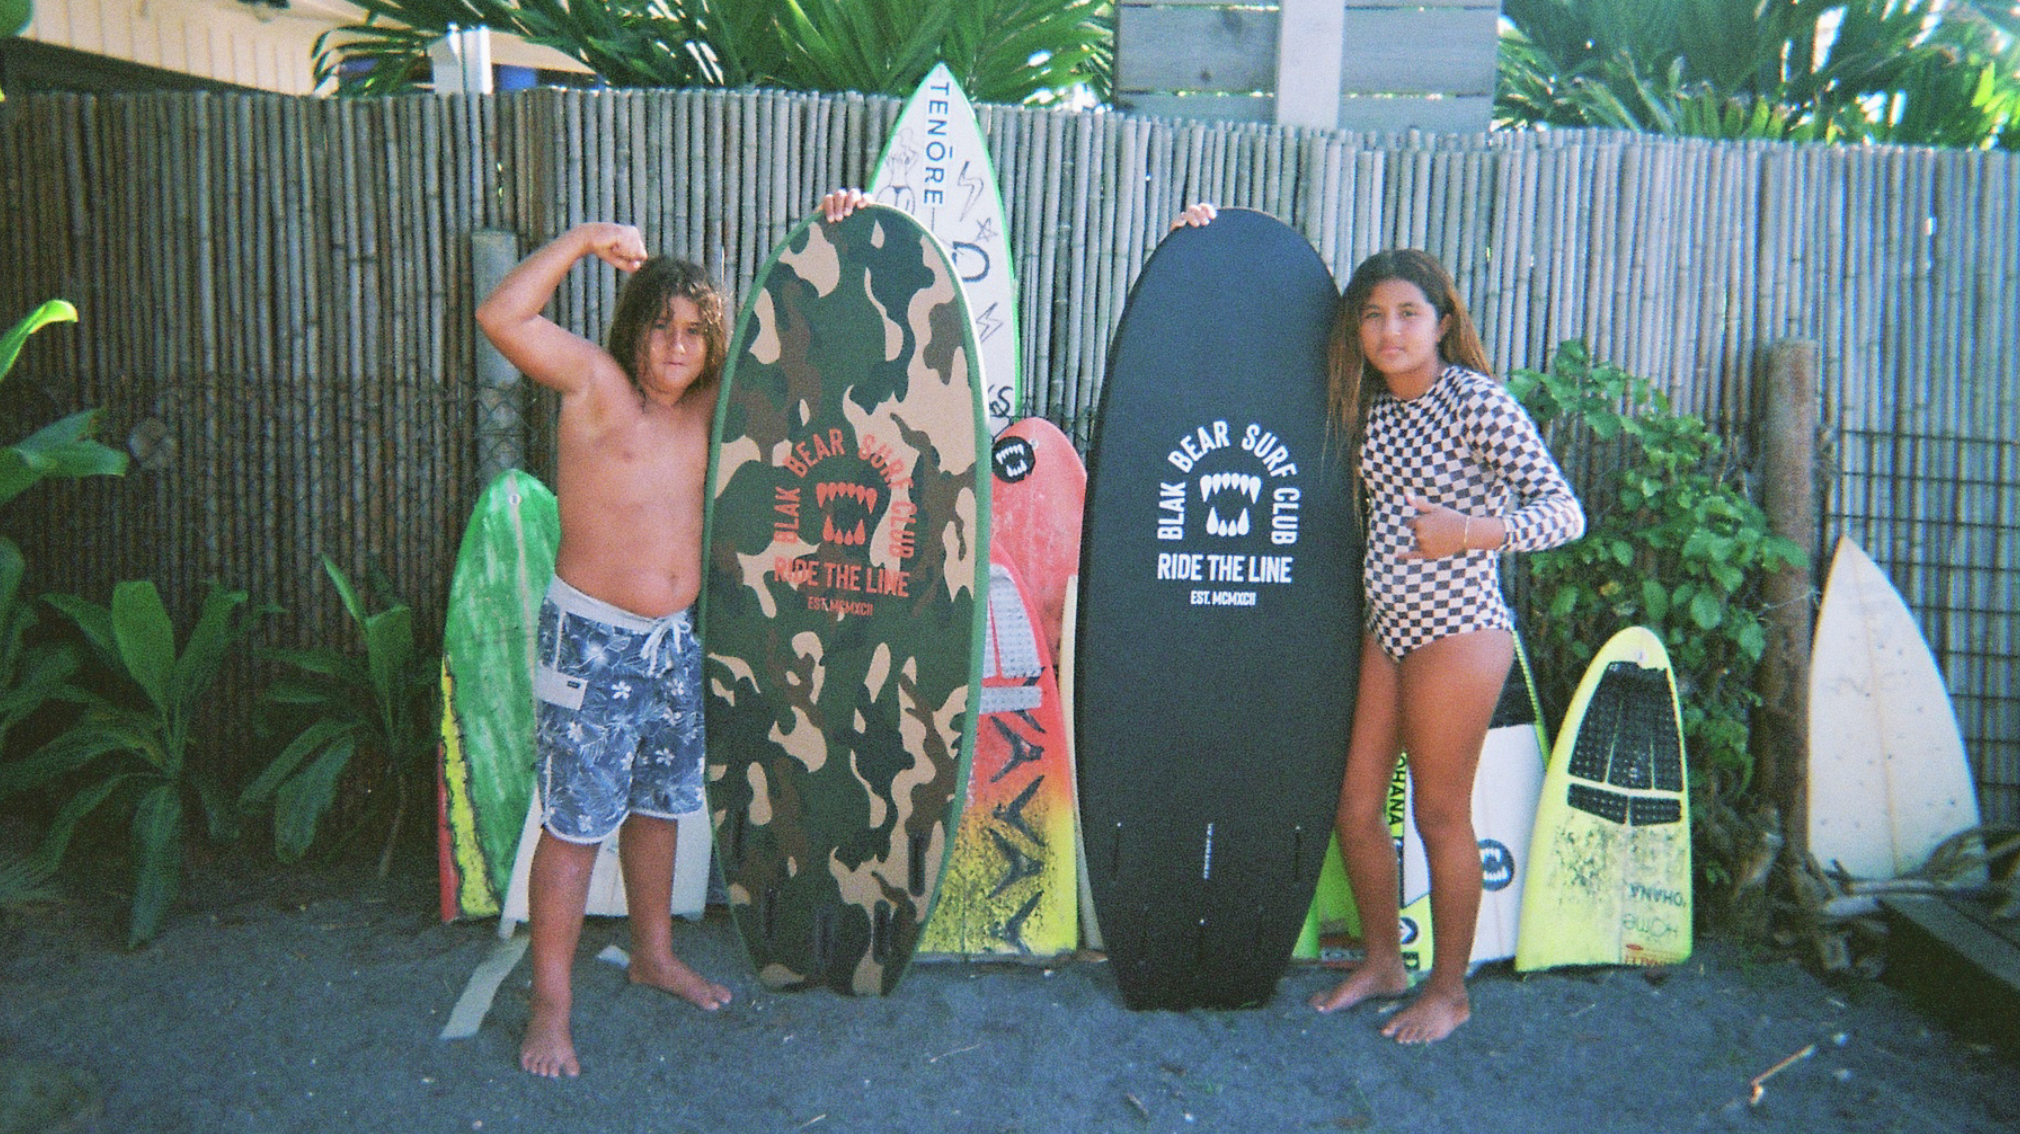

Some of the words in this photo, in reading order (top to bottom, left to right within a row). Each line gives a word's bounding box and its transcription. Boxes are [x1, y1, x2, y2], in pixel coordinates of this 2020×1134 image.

[782, 428, 845, 478] BEAR
[858, 434, 914, 490] SURF
[1167, 420, 1230, 473] BEAR
[1241, 424, 1297, 477] SURF
[773, 486, 800, 544] BLAK
[888, 501, 917, 559] CLUB
[1157, 481, 1186, 540] BLAK
[1270, 487, 1300, 545] CLUB
[773, 556, 820, 587] RIDE
[824, 562, 862, 592] THE
[866, 568, 910, 598] LINE
[1157, 553, 1203, 581] RIDE
[1207, 555, 1245, 582] THE
[1248, 556, 1294, 583] LINE
[807, 596, 828, 611] EST.
[1190, 590, 1210, 605] EST.
[1212, 591, 1257, 606] MCMXCII
